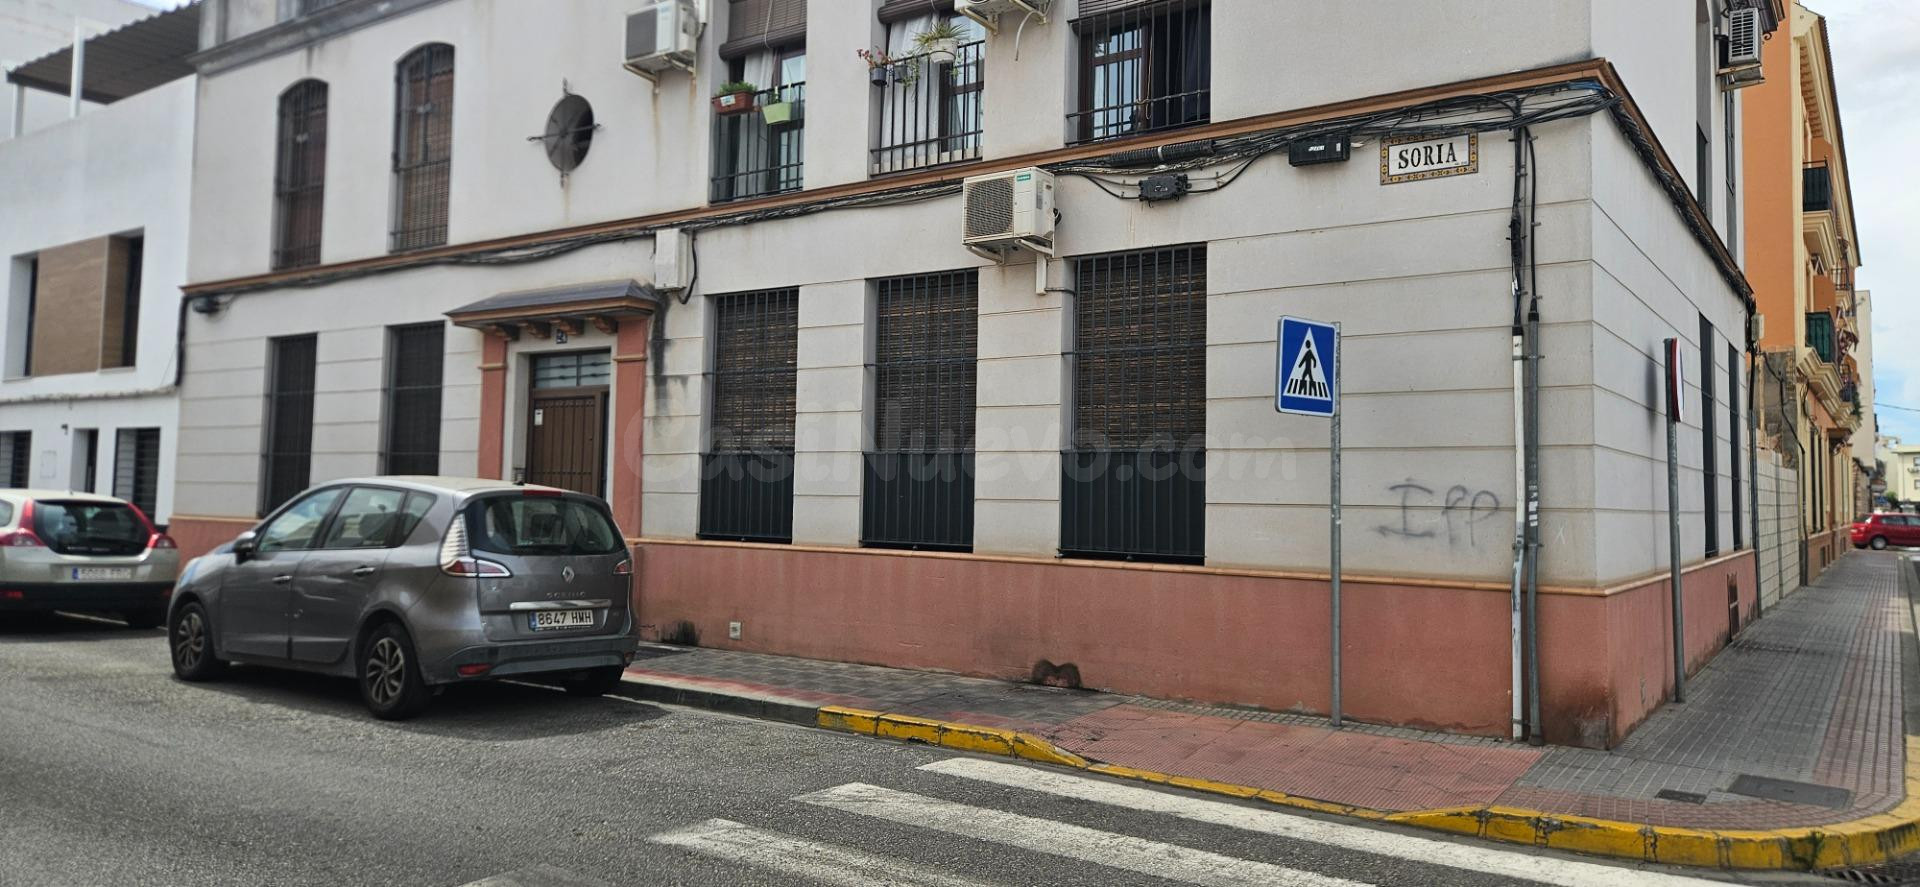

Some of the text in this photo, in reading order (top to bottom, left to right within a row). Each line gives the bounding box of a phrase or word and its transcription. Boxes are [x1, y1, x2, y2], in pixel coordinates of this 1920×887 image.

[1398, 142, 1457, 169] SORIA
[537, 610, 592, 625] 8647 HMH
